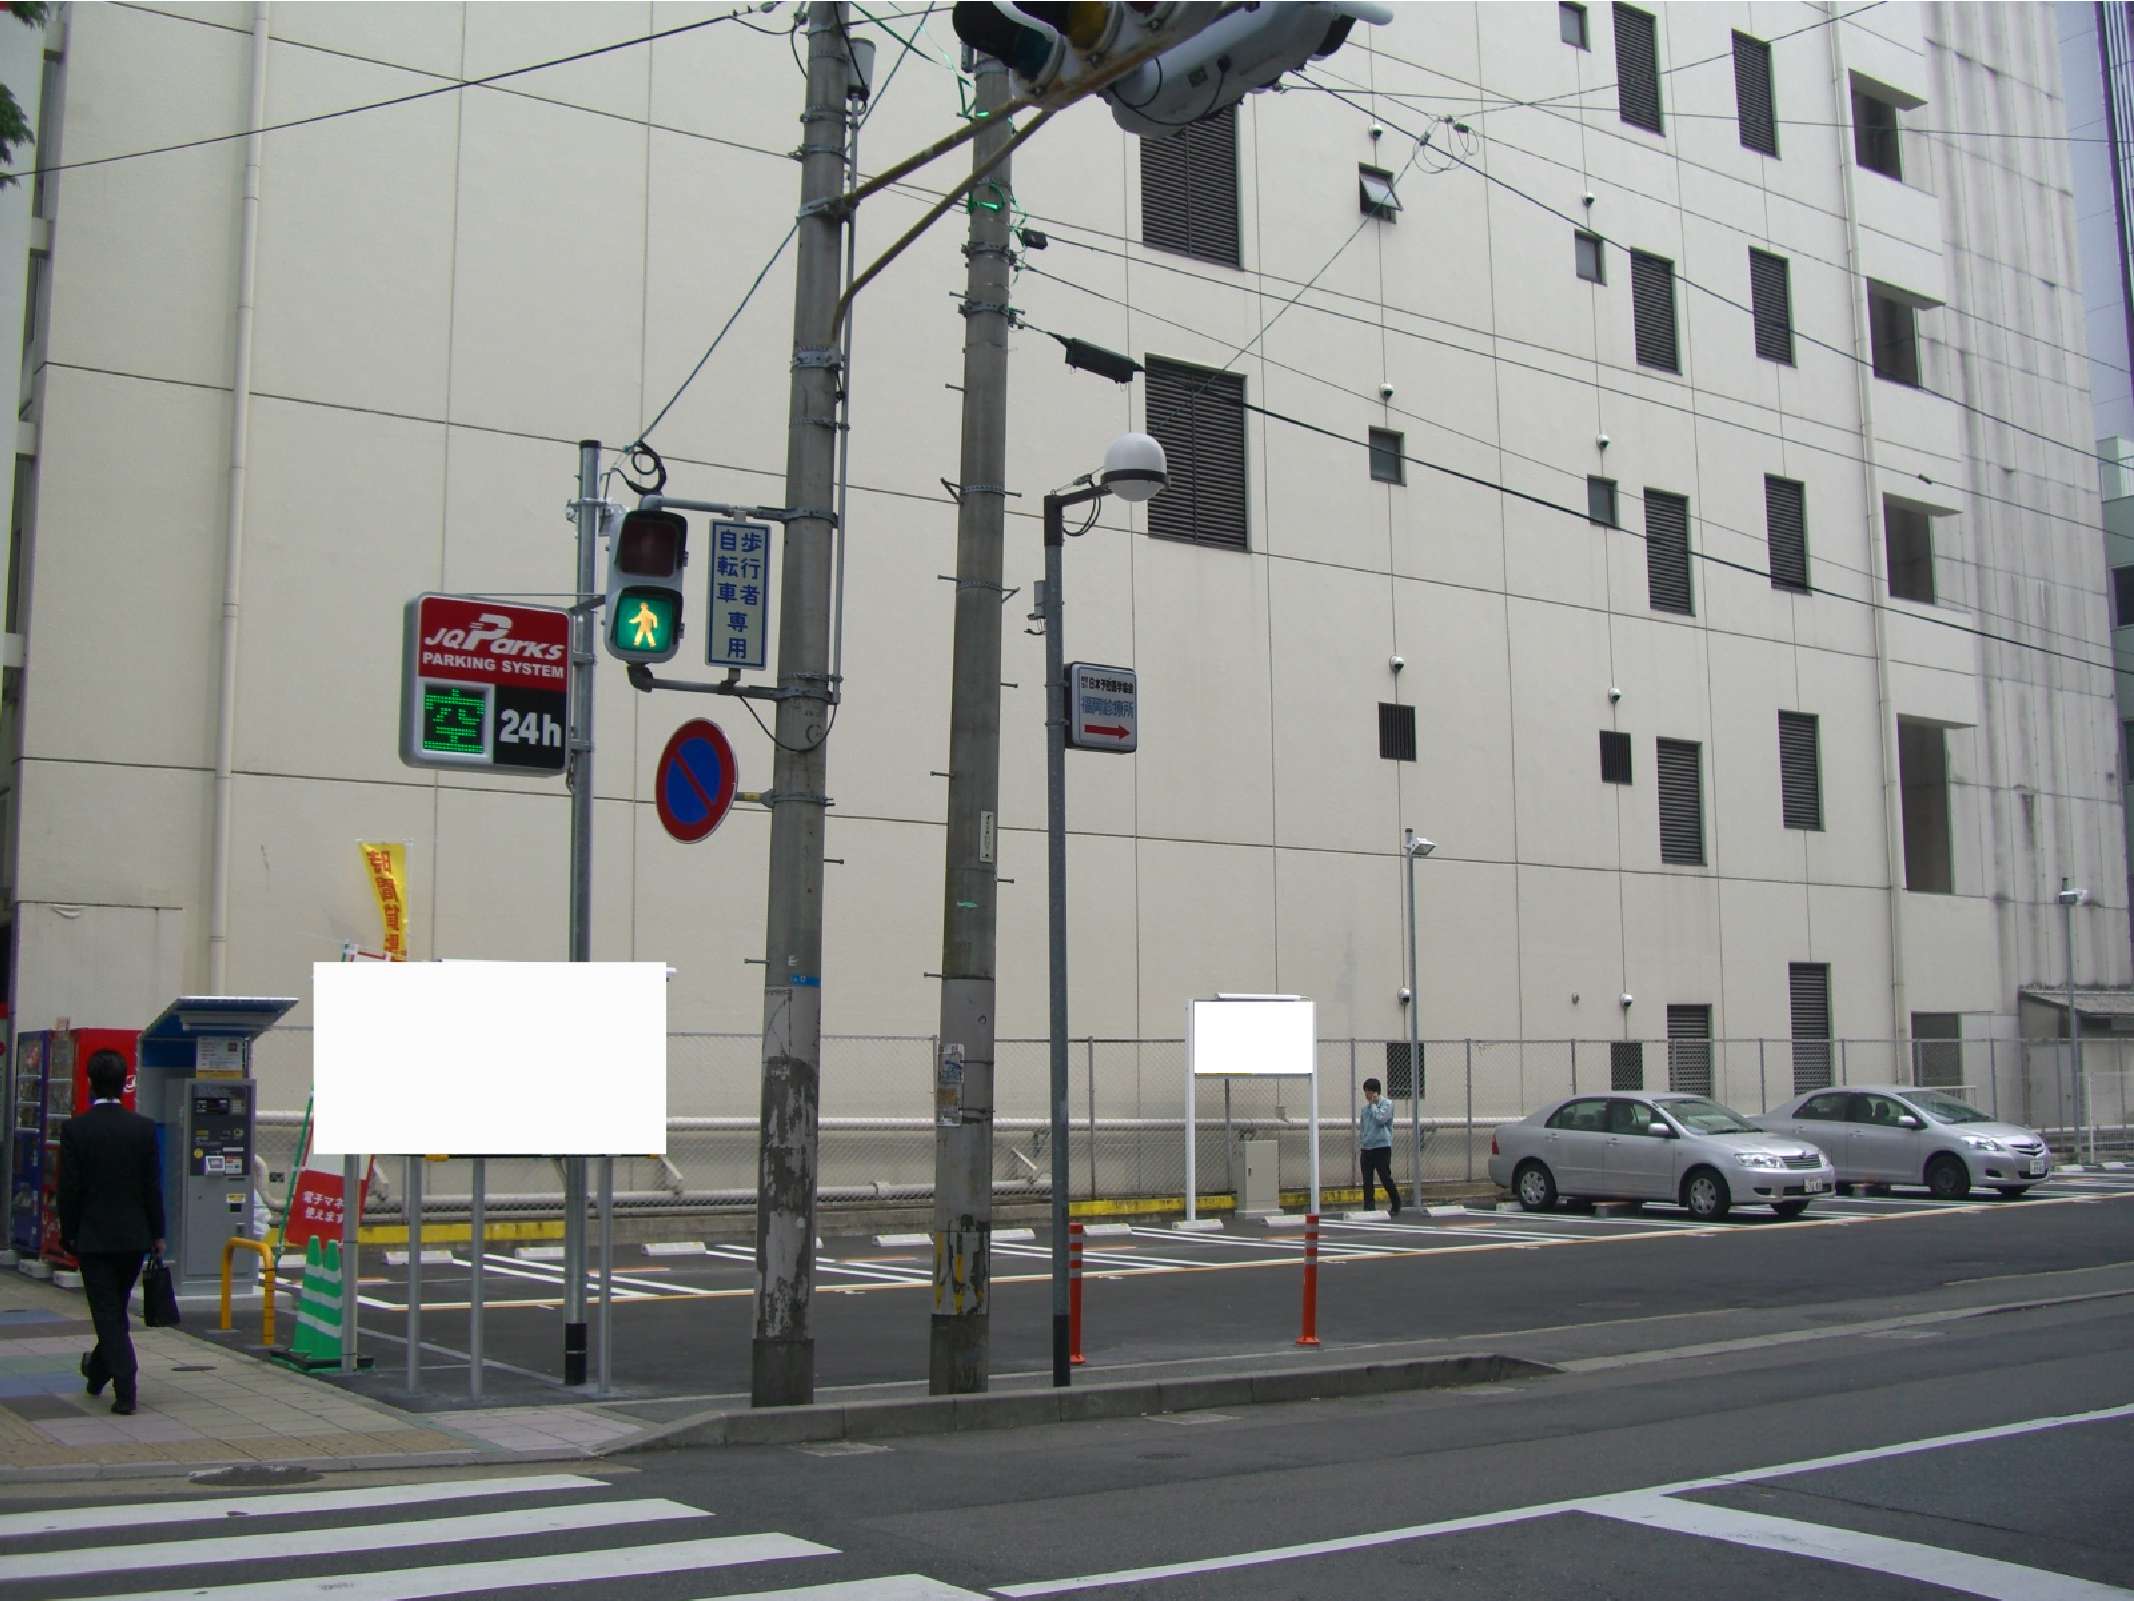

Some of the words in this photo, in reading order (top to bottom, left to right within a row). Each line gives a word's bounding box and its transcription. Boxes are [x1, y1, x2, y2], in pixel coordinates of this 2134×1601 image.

[717, 529, 739, 603] 自転車
[740, 531, 762, 605] 歩行者
[727, 611, 749, 659] 専用
[422, 652, 496, 671] PARKING
[502, 660, 564, 679] SYSTEM
[422, 687, 487, 754] 空
[499, 708, 562, 748] 24h
